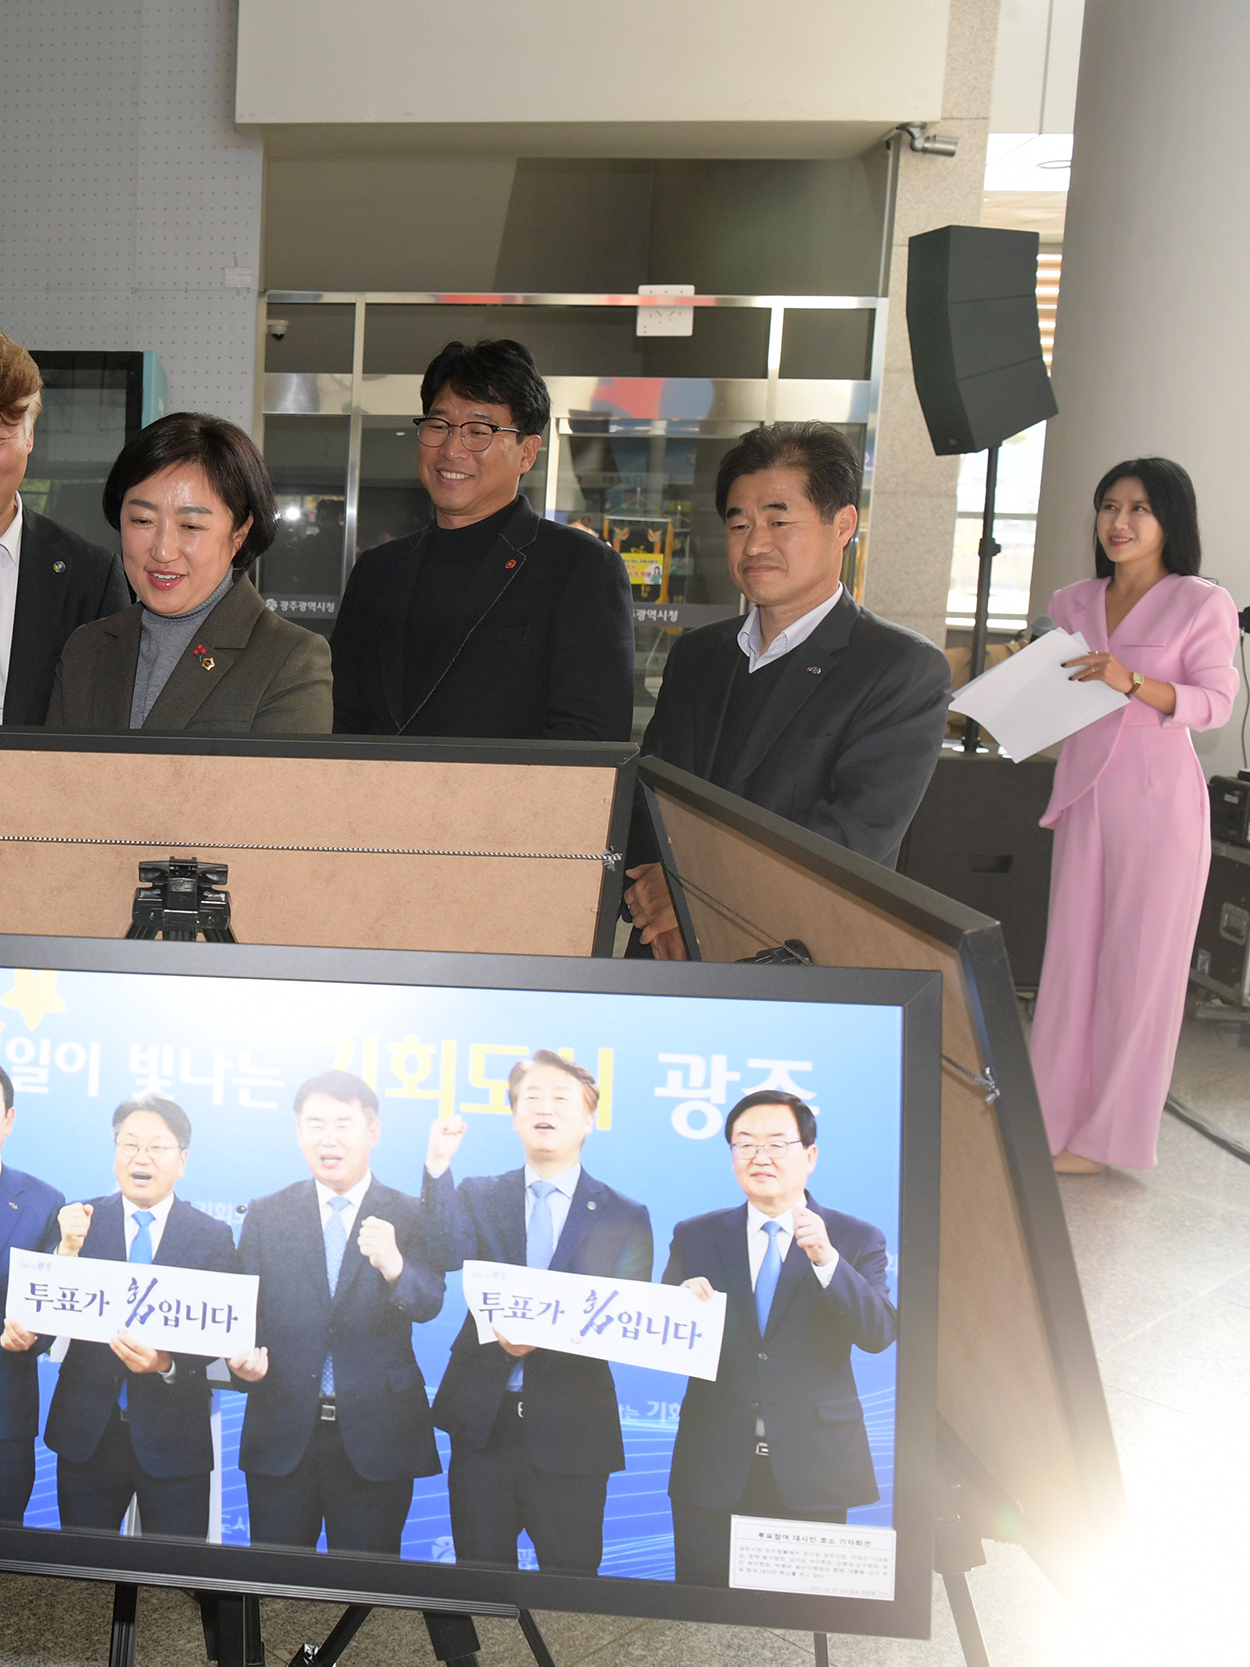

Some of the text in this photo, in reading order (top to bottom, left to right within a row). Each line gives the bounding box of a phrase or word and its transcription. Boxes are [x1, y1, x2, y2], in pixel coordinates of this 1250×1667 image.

[280, 600, 335, 614] 광주광역시청
[128, 1043, 286, 1110] 빛나는
[24, 1282, 111, 1317] 투표가
[478, 1291, 566, 1325] 투표가
[758, 1532, 871, 1547] 투표참여 대시민 호소 기자회견
